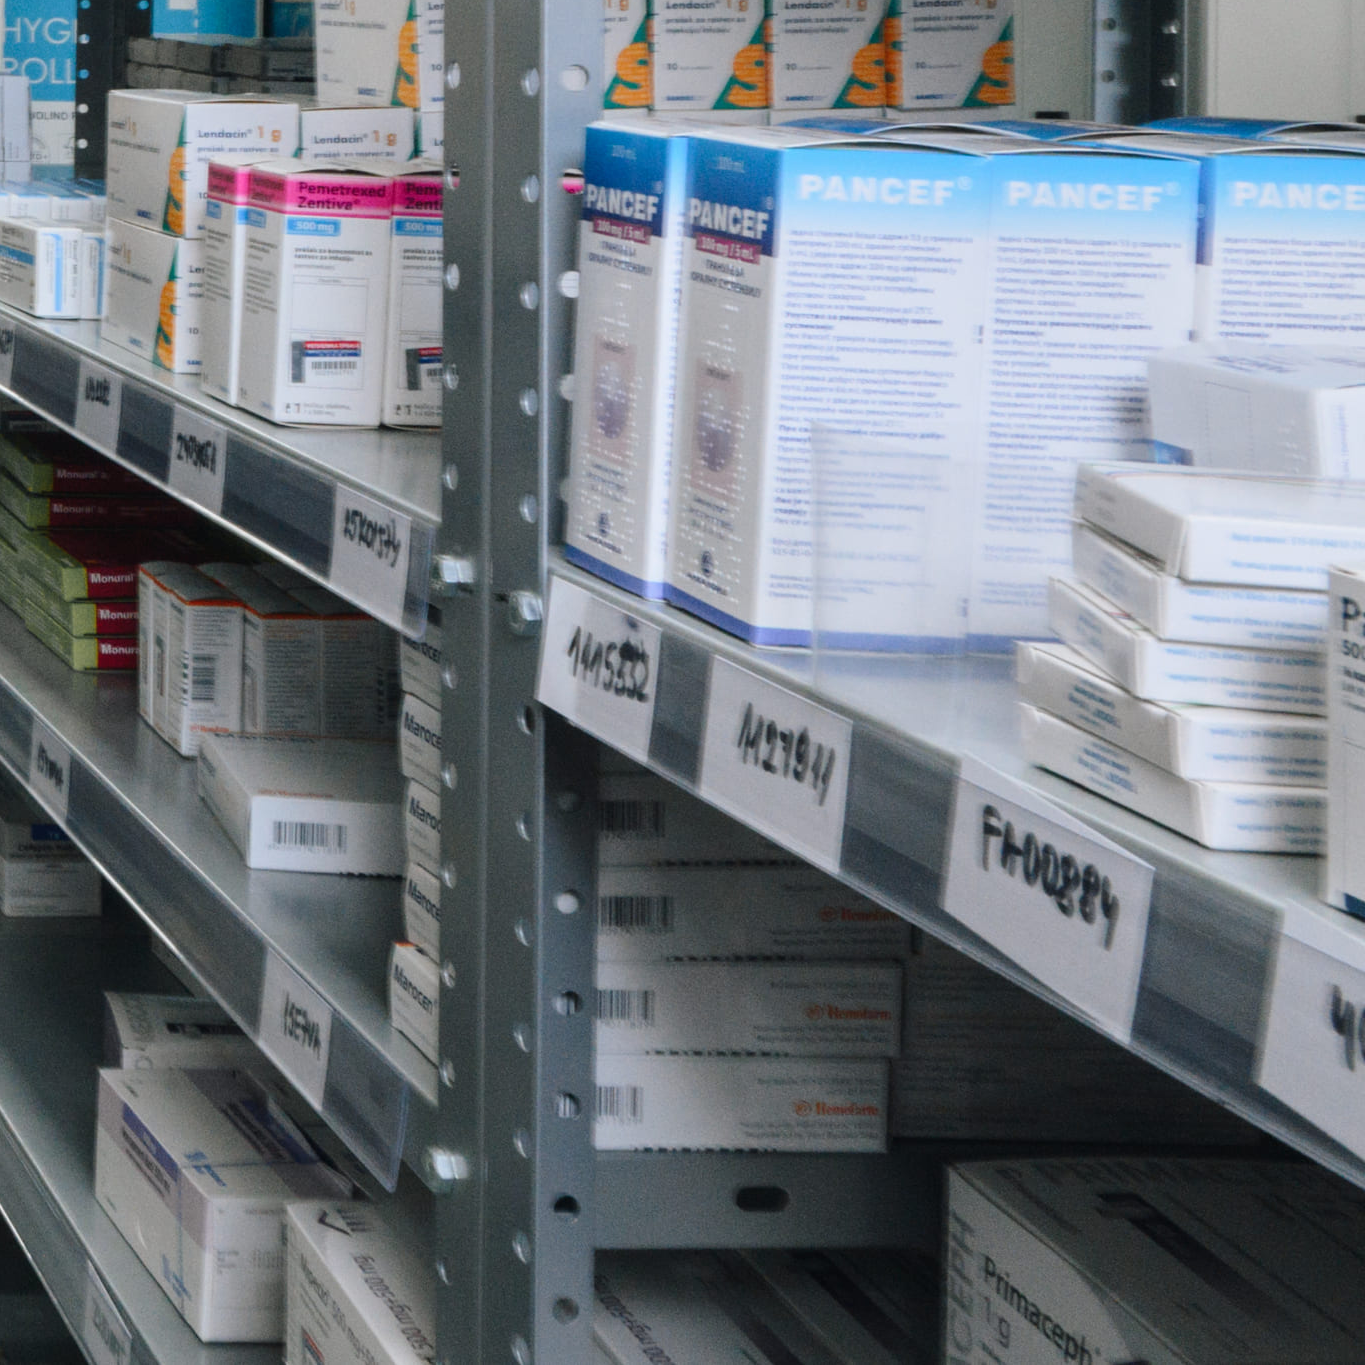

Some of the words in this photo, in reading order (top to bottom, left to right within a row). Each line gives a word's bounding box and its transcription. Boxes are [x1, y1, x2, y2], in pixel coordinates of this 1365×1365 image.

[298, 196, 354, 211] Zentiva
[299, 182, 386, 198] Pemetrexed
[587, 184, 659, 222] PANCEF
[799, 174, 955, 205] PANCEF
[1007, 182, 1164, 211] PANCEF
[690, 198, 769, 239] PANCEF
[90, 572, 134, 585] Monural
[403, 712, 442, 751] Maroce
[406, 879, 442, 923] Maroce
